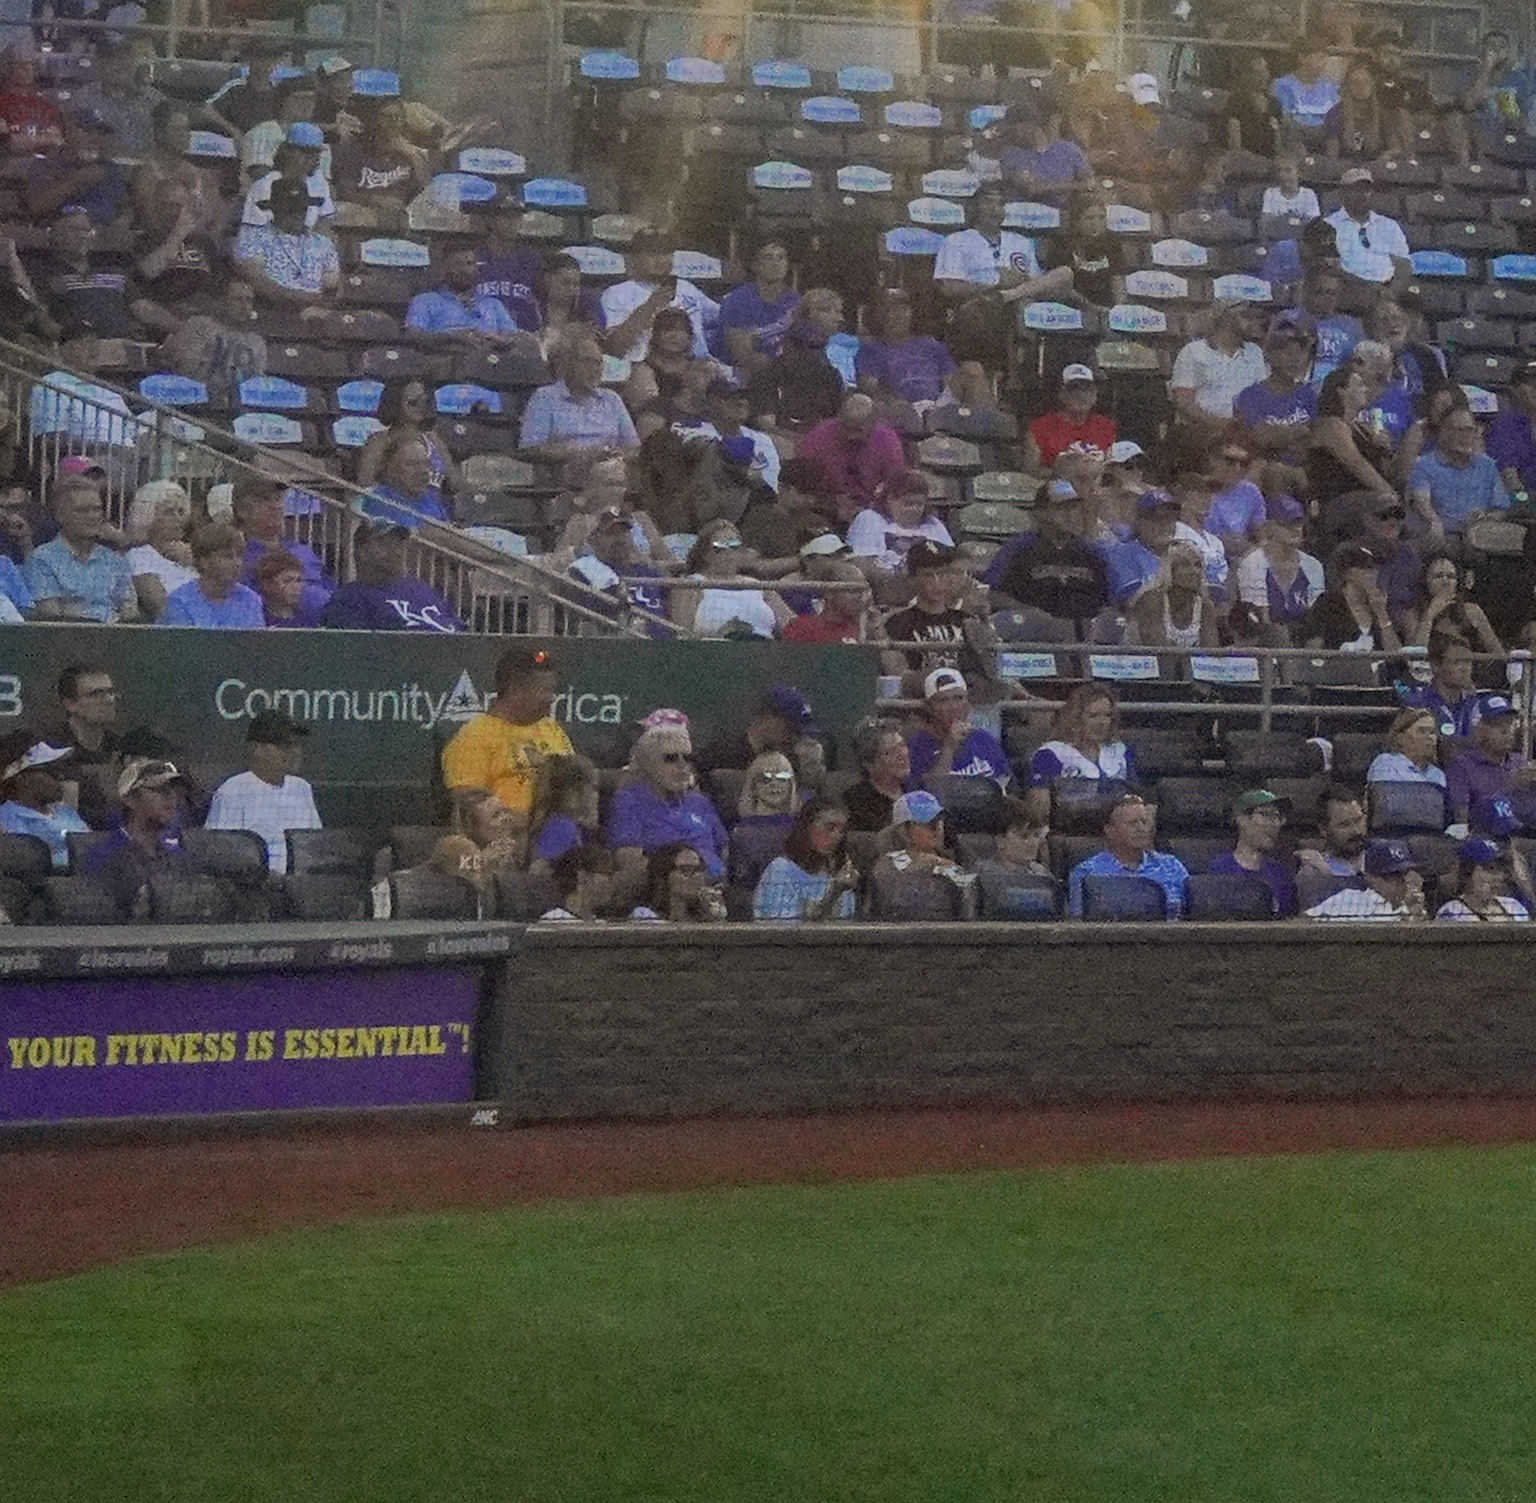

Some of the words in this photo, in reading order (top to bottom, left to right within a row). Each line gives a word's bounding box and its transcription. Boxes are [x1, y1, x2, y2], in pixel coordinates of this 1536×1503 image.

[384, 598, 455, 634] KC
[8, 1035, 97, 1069] YOUR
[105, 1030, 237, 1066] FITNESS
[245, 1030, 276, 1062] IS
